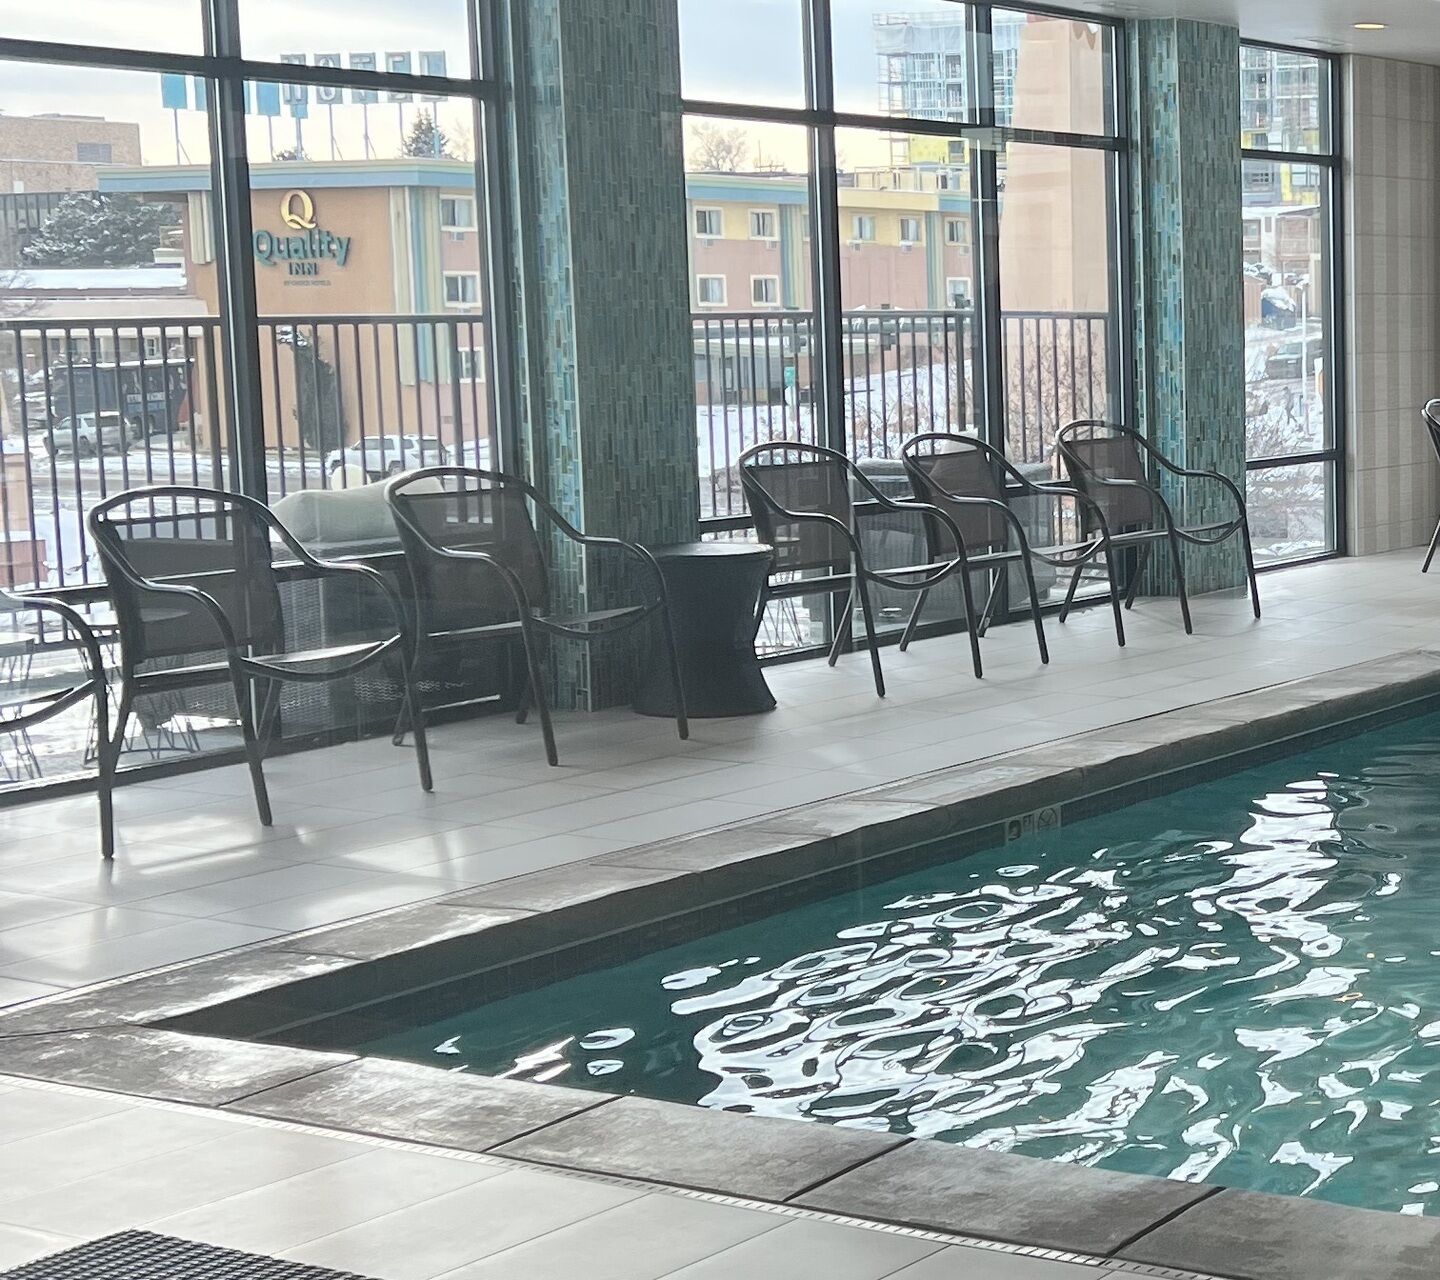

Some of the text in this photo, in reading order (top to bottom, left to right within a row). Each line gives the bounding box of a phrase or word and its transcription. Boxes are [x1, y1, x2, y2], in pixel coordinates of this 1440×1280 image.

[281, 189, 317, 230] Q
[253, 230, 351, 267] Quality
[289, 262, 318, 275] INN
